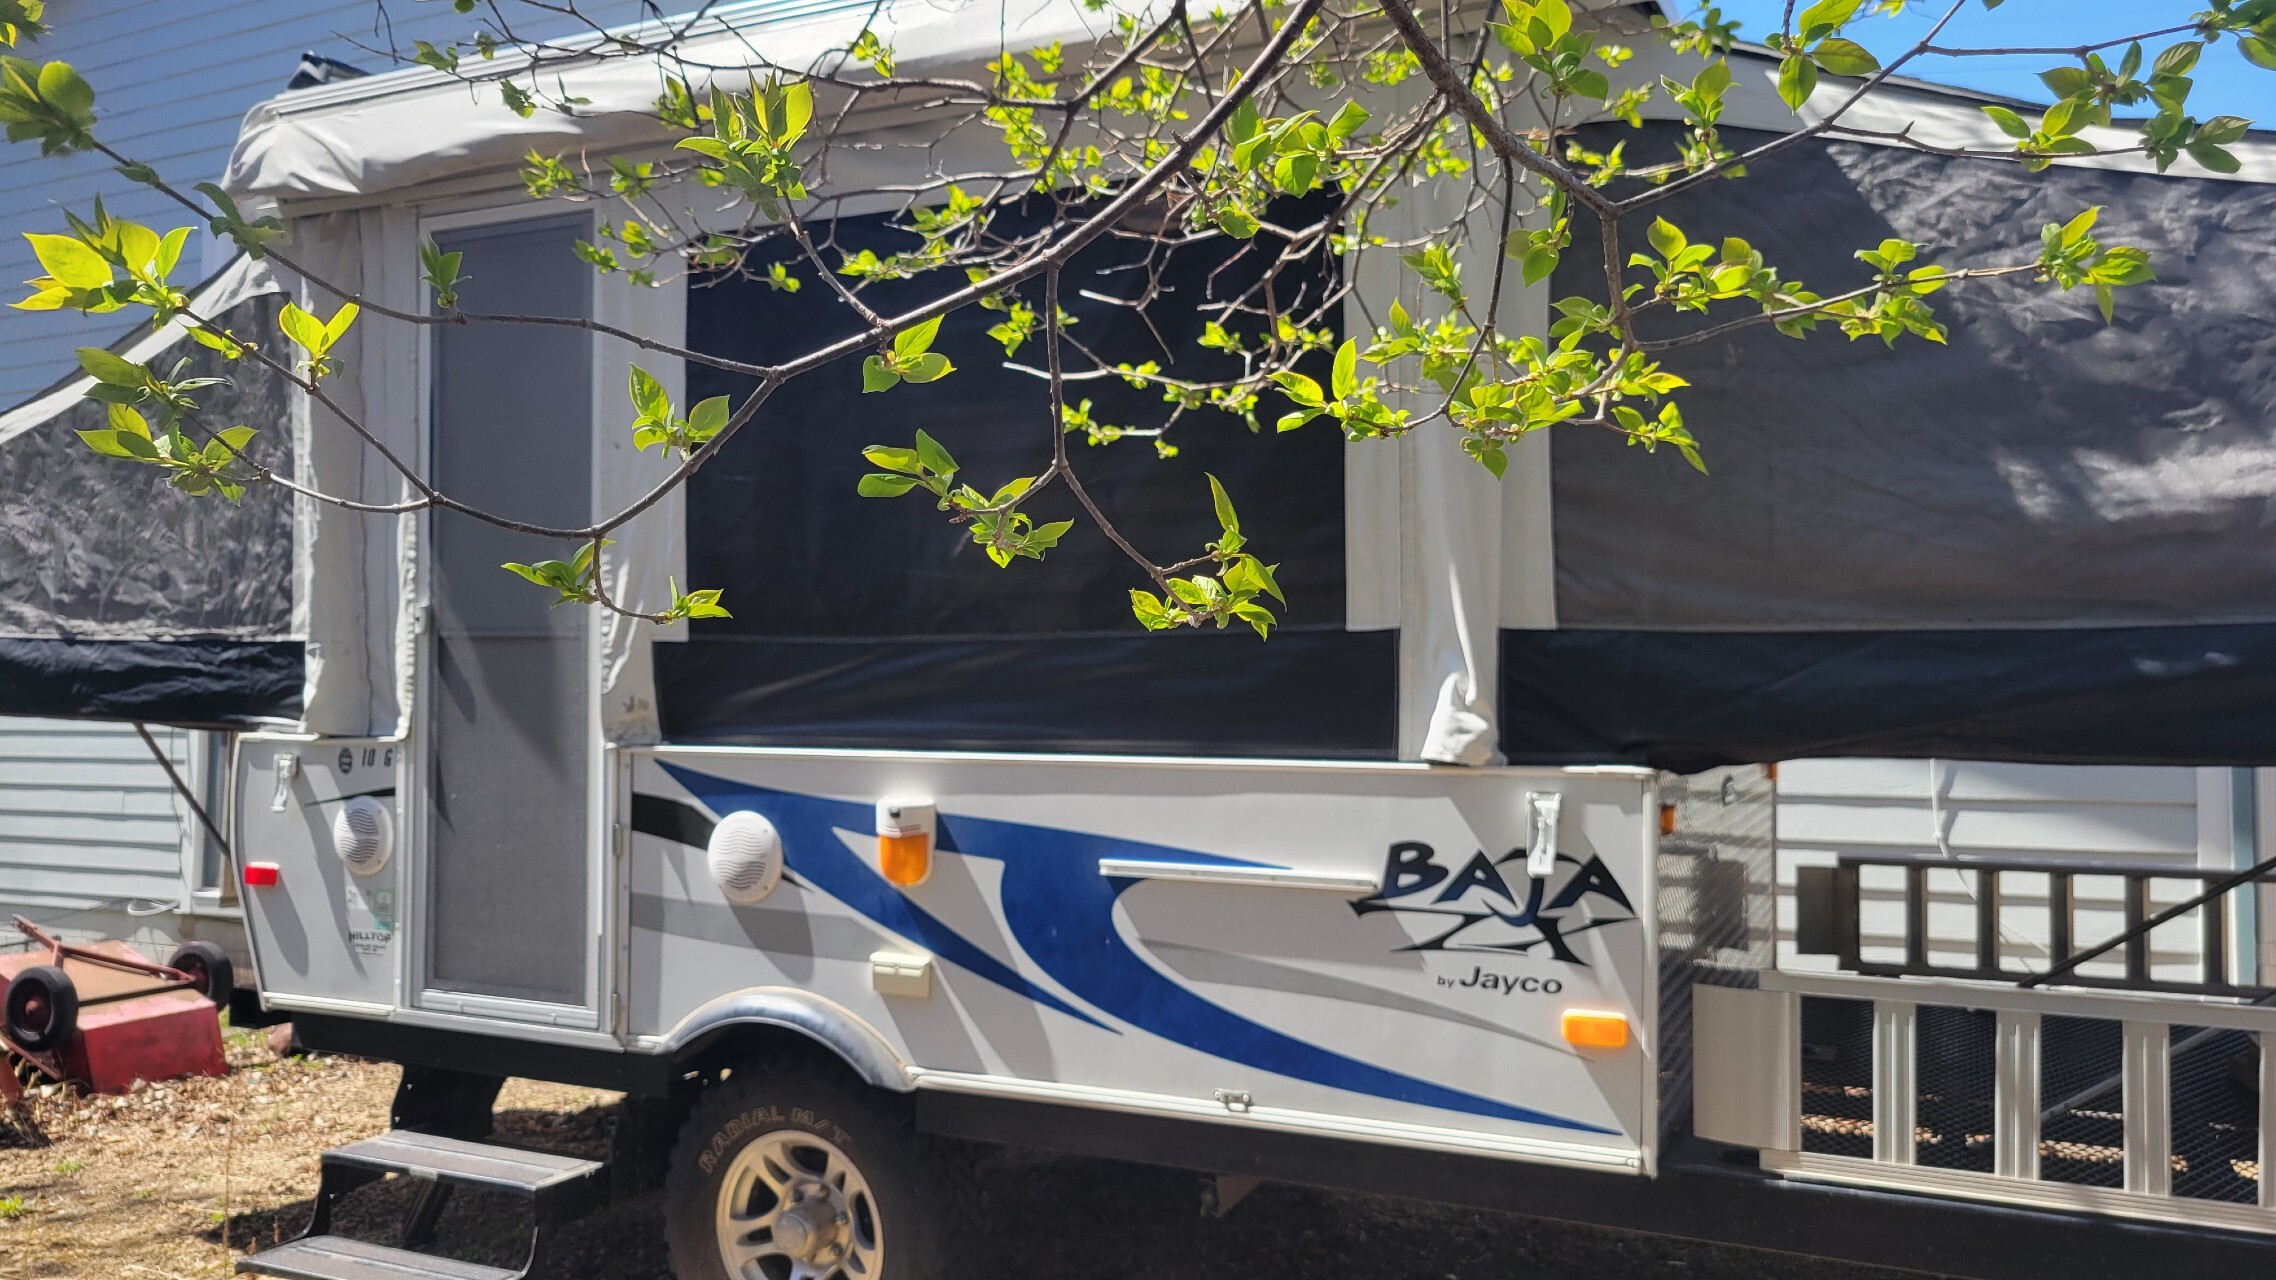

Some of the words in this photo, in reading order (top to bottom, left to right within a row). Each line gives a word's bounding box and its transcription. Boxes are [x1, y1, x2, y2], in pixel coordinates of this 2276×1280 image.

[1378, 840, 1637, 927] BAJA
[1437, 974, 1454, 988] by
[1459, 966, 1563, 995] Jayco
[698, 1105, 785, 1175] RADIAL
